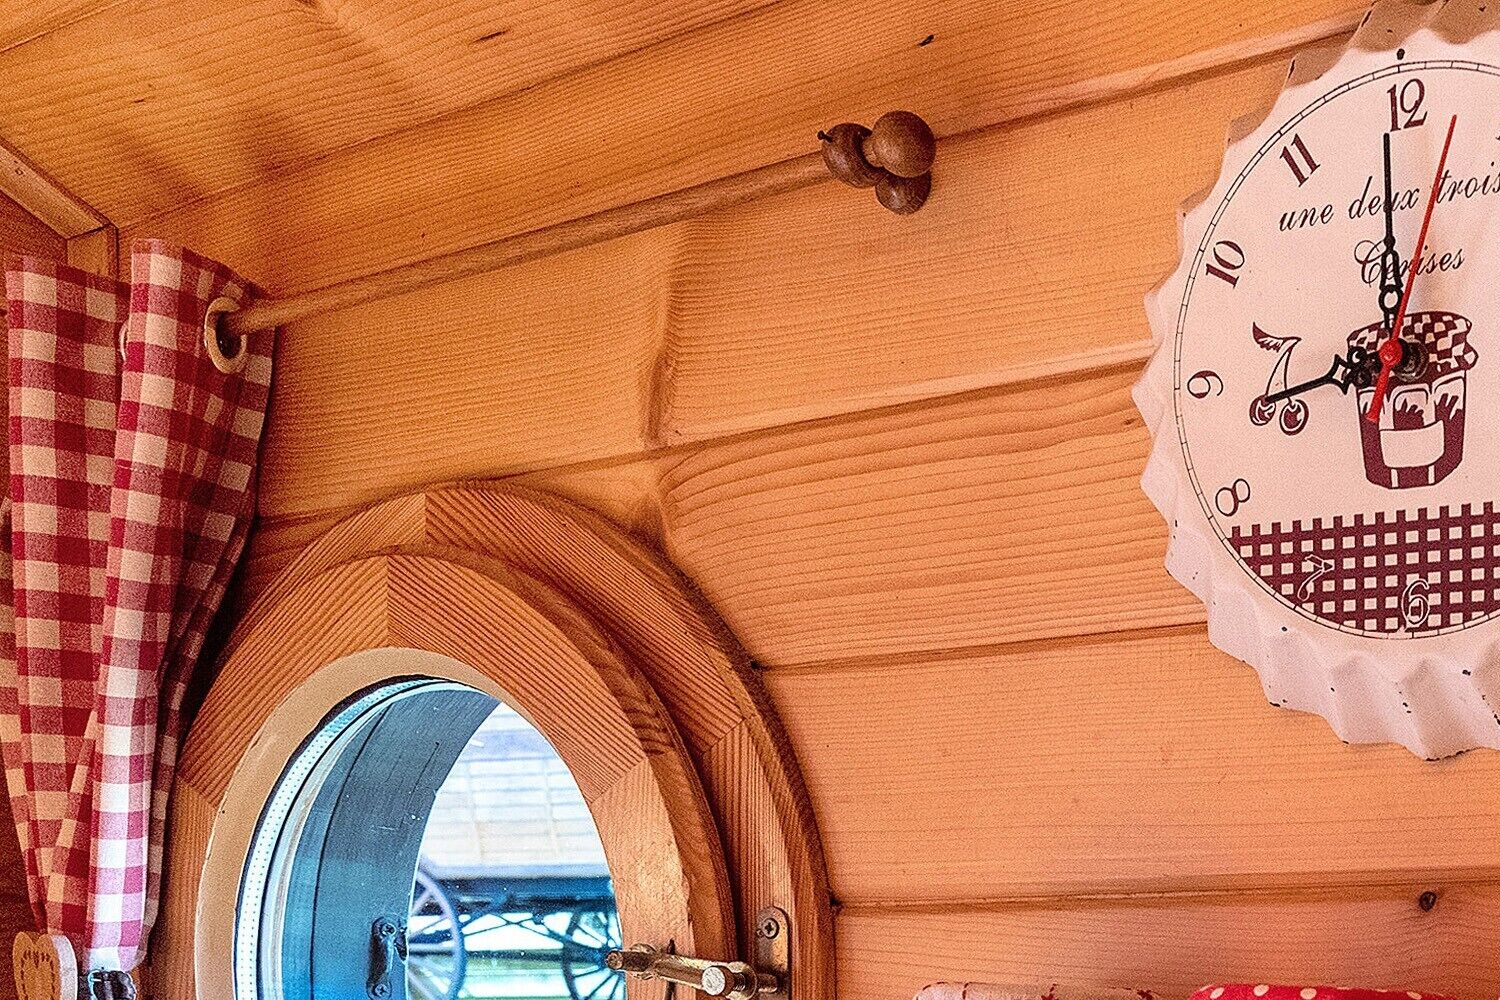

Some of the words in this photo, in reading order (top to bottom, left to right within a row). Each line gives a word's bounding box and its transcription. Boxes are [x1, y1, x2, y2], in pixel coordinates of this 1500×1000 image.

[1386, 78, 1428, 132] 12
[1279, 133, 1321, 187] 11
[1278, 203, 1334, 232] une
[1348, 175, 1420, 219] deux
[1205, 240, 1247, 289] 10
[1187, 369, 1224, 399] 9
[1214, 478, 1252, 516] 8
[1296, 553, 1335, 601] 7
[1400, 578, 1431, 627] 6
